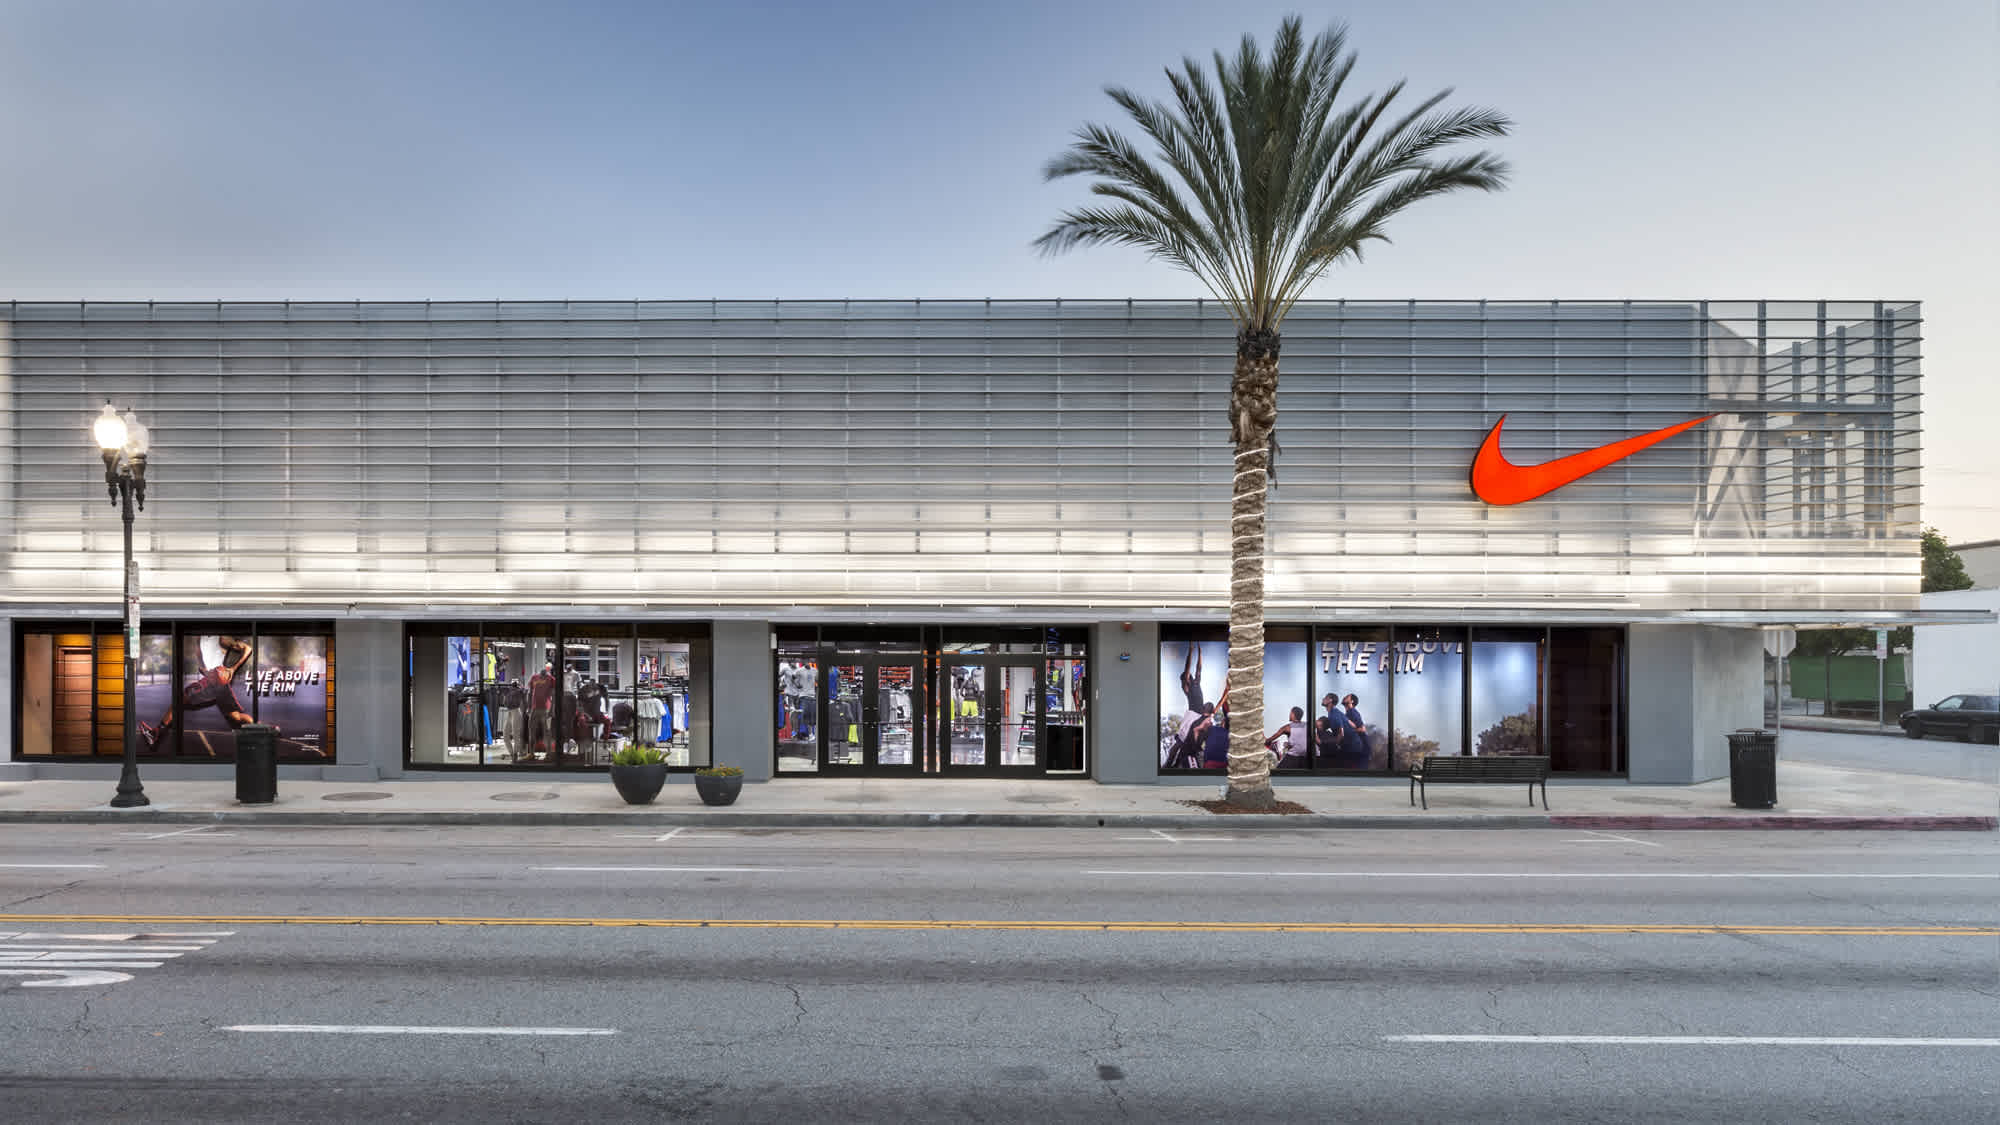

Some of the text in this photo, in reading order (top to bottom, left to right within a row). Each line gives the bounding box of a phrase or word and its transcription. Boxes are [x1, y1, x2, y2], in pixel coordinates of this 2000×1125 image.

[1322, 653, 1425, 672] THE RIM
[245, 670, 319, 681] LVE ABOVE
[272, 682, 296, 692] RIM
